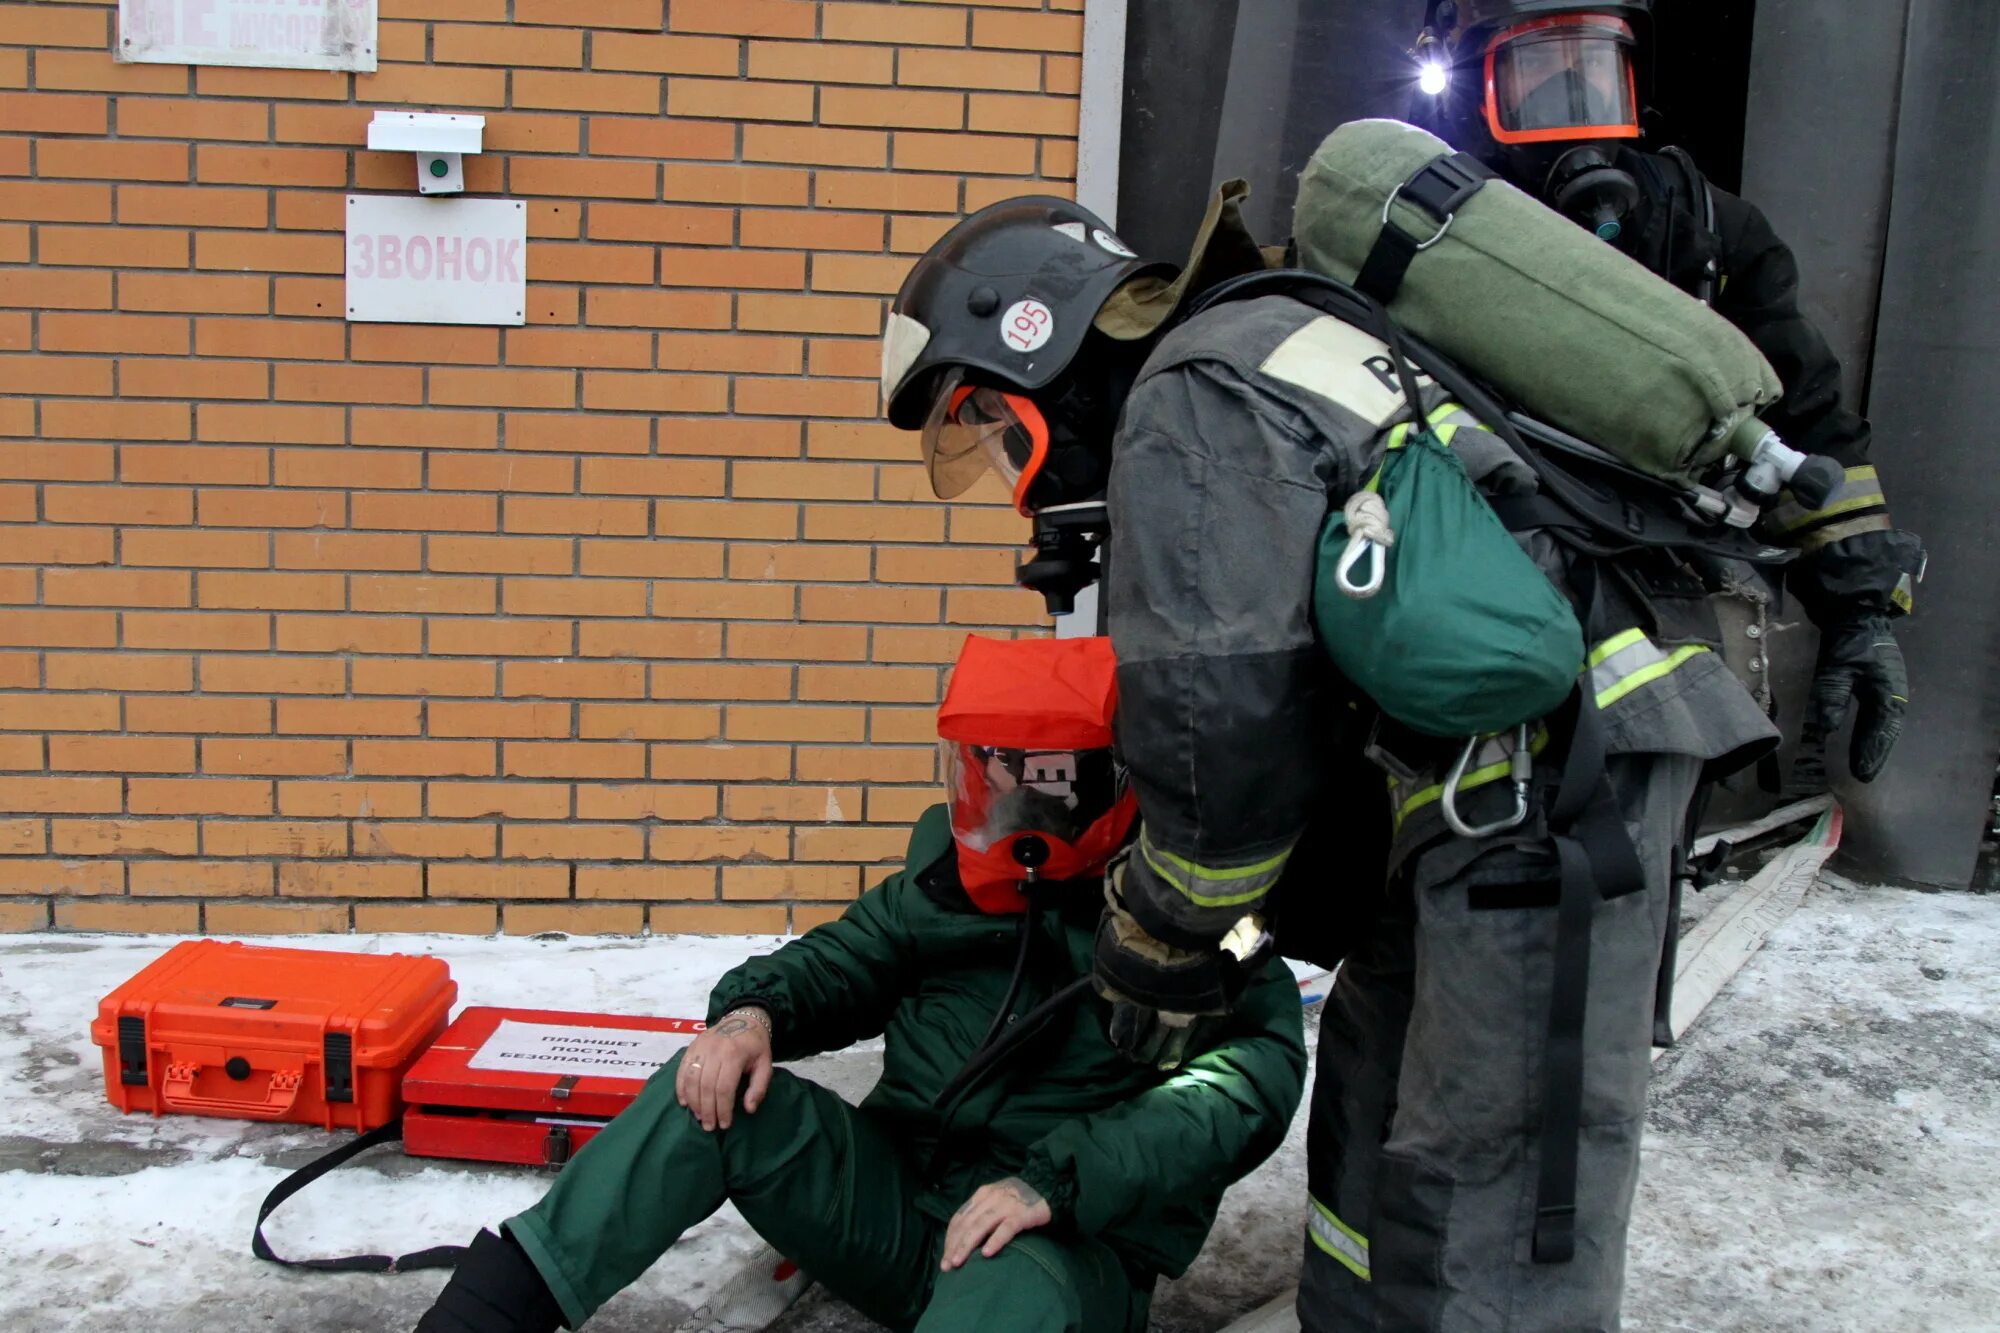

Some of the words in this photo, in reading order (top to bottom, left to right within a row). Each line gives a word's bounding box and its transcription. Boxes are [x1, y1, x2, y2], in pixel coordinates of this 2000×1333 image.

[351, 233, 521, 283] ЗВОНОК
[1008, 302, 1048, 349] 195
[541, 1036, 642, 1048] ПЛАНШЕТ
[551, 1046, 619, 1056] ПОСТА
[499, 1052, 665, 1068] БЕЗОПАСНОСТИ
